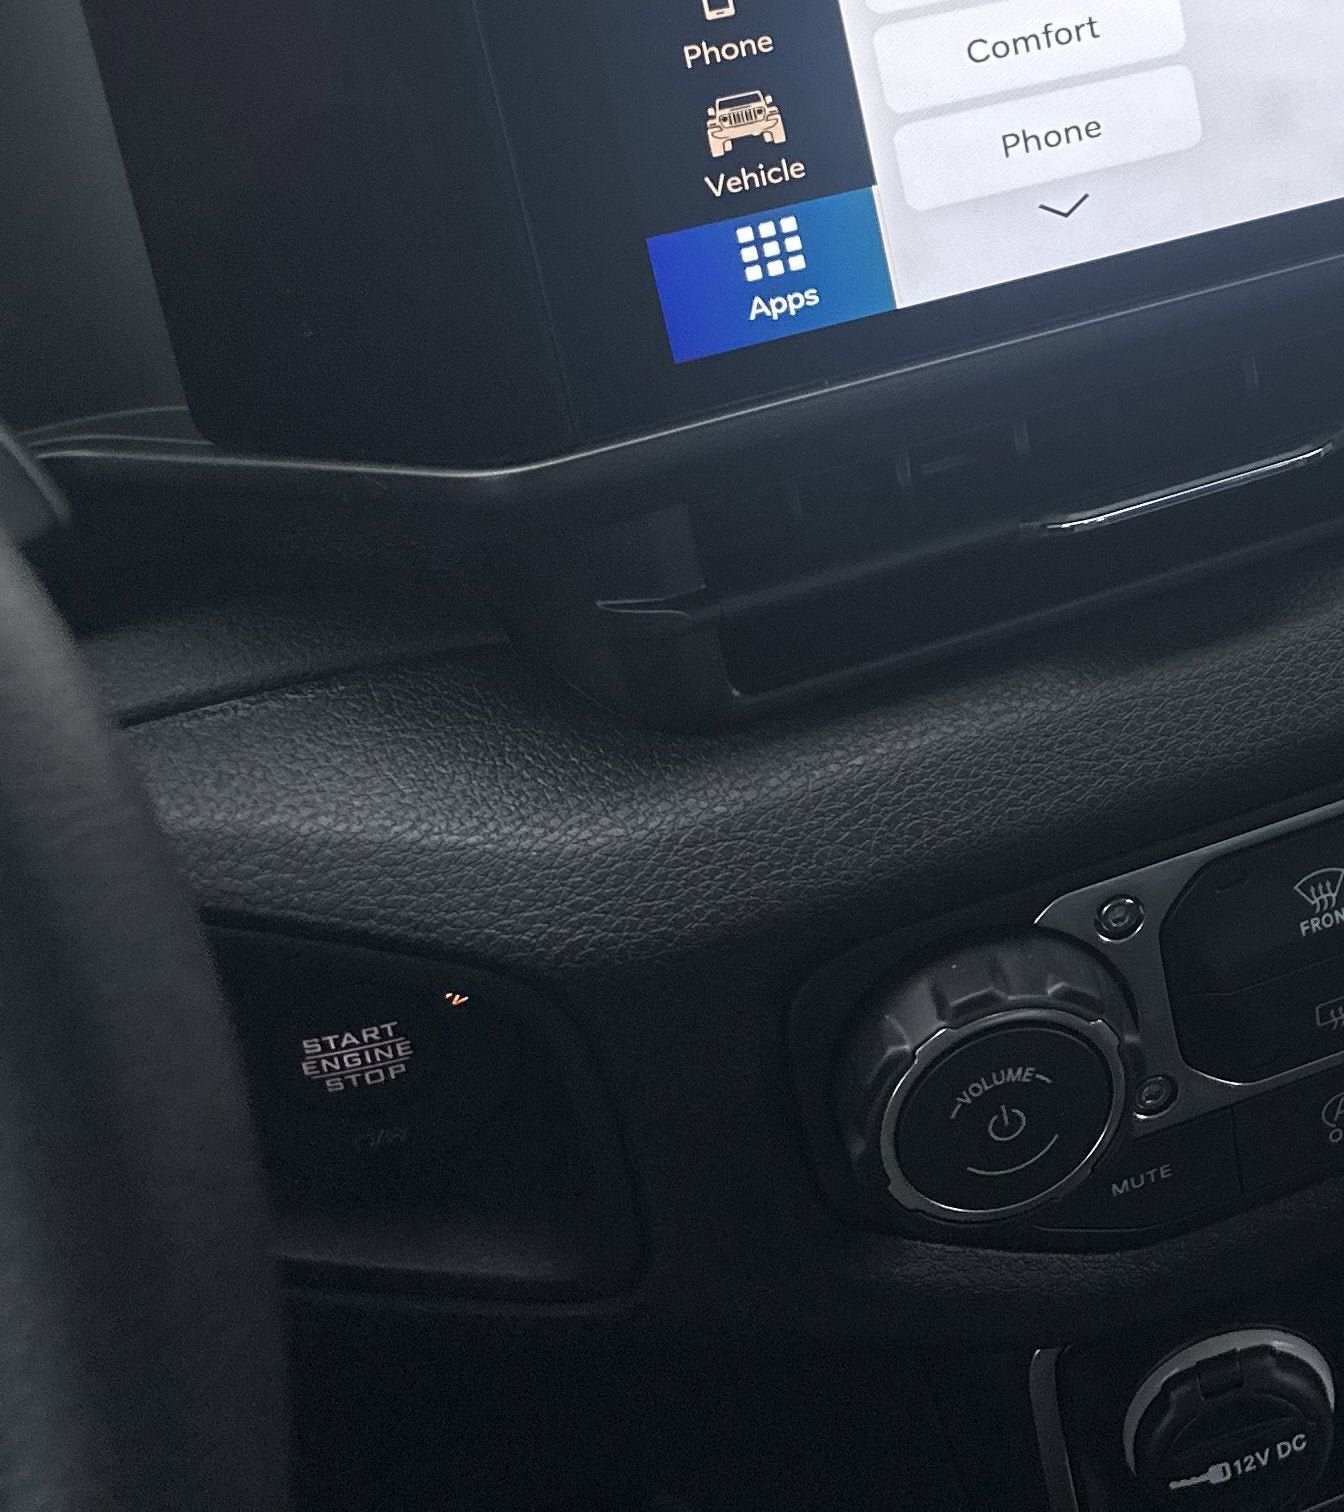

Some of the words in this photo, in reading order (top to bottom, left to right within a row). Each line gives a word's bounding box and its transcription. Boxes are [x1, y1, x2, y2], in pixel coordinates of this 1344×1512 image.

[683, 32, 774, 68] Phone
[967, 16, 1101, 64] Comfort
[1001, 120, 1103, 159] Phone
[704, 157, 806, 197] Vehicle
[749, 288, 820, 321] Apps
[302, 1021, 399, 1055] START
[301, 1040, 414, 1075] ENGINE
[325, 1063, 407, 1093] STOP
[956, 1066, 1035, 1104] VOLUME
[1111, 1163, 1173, 1197] MUTE
[1233, 1447, 1270, 1475] 12V
[1276, 1433, 1308, 1460] DC
